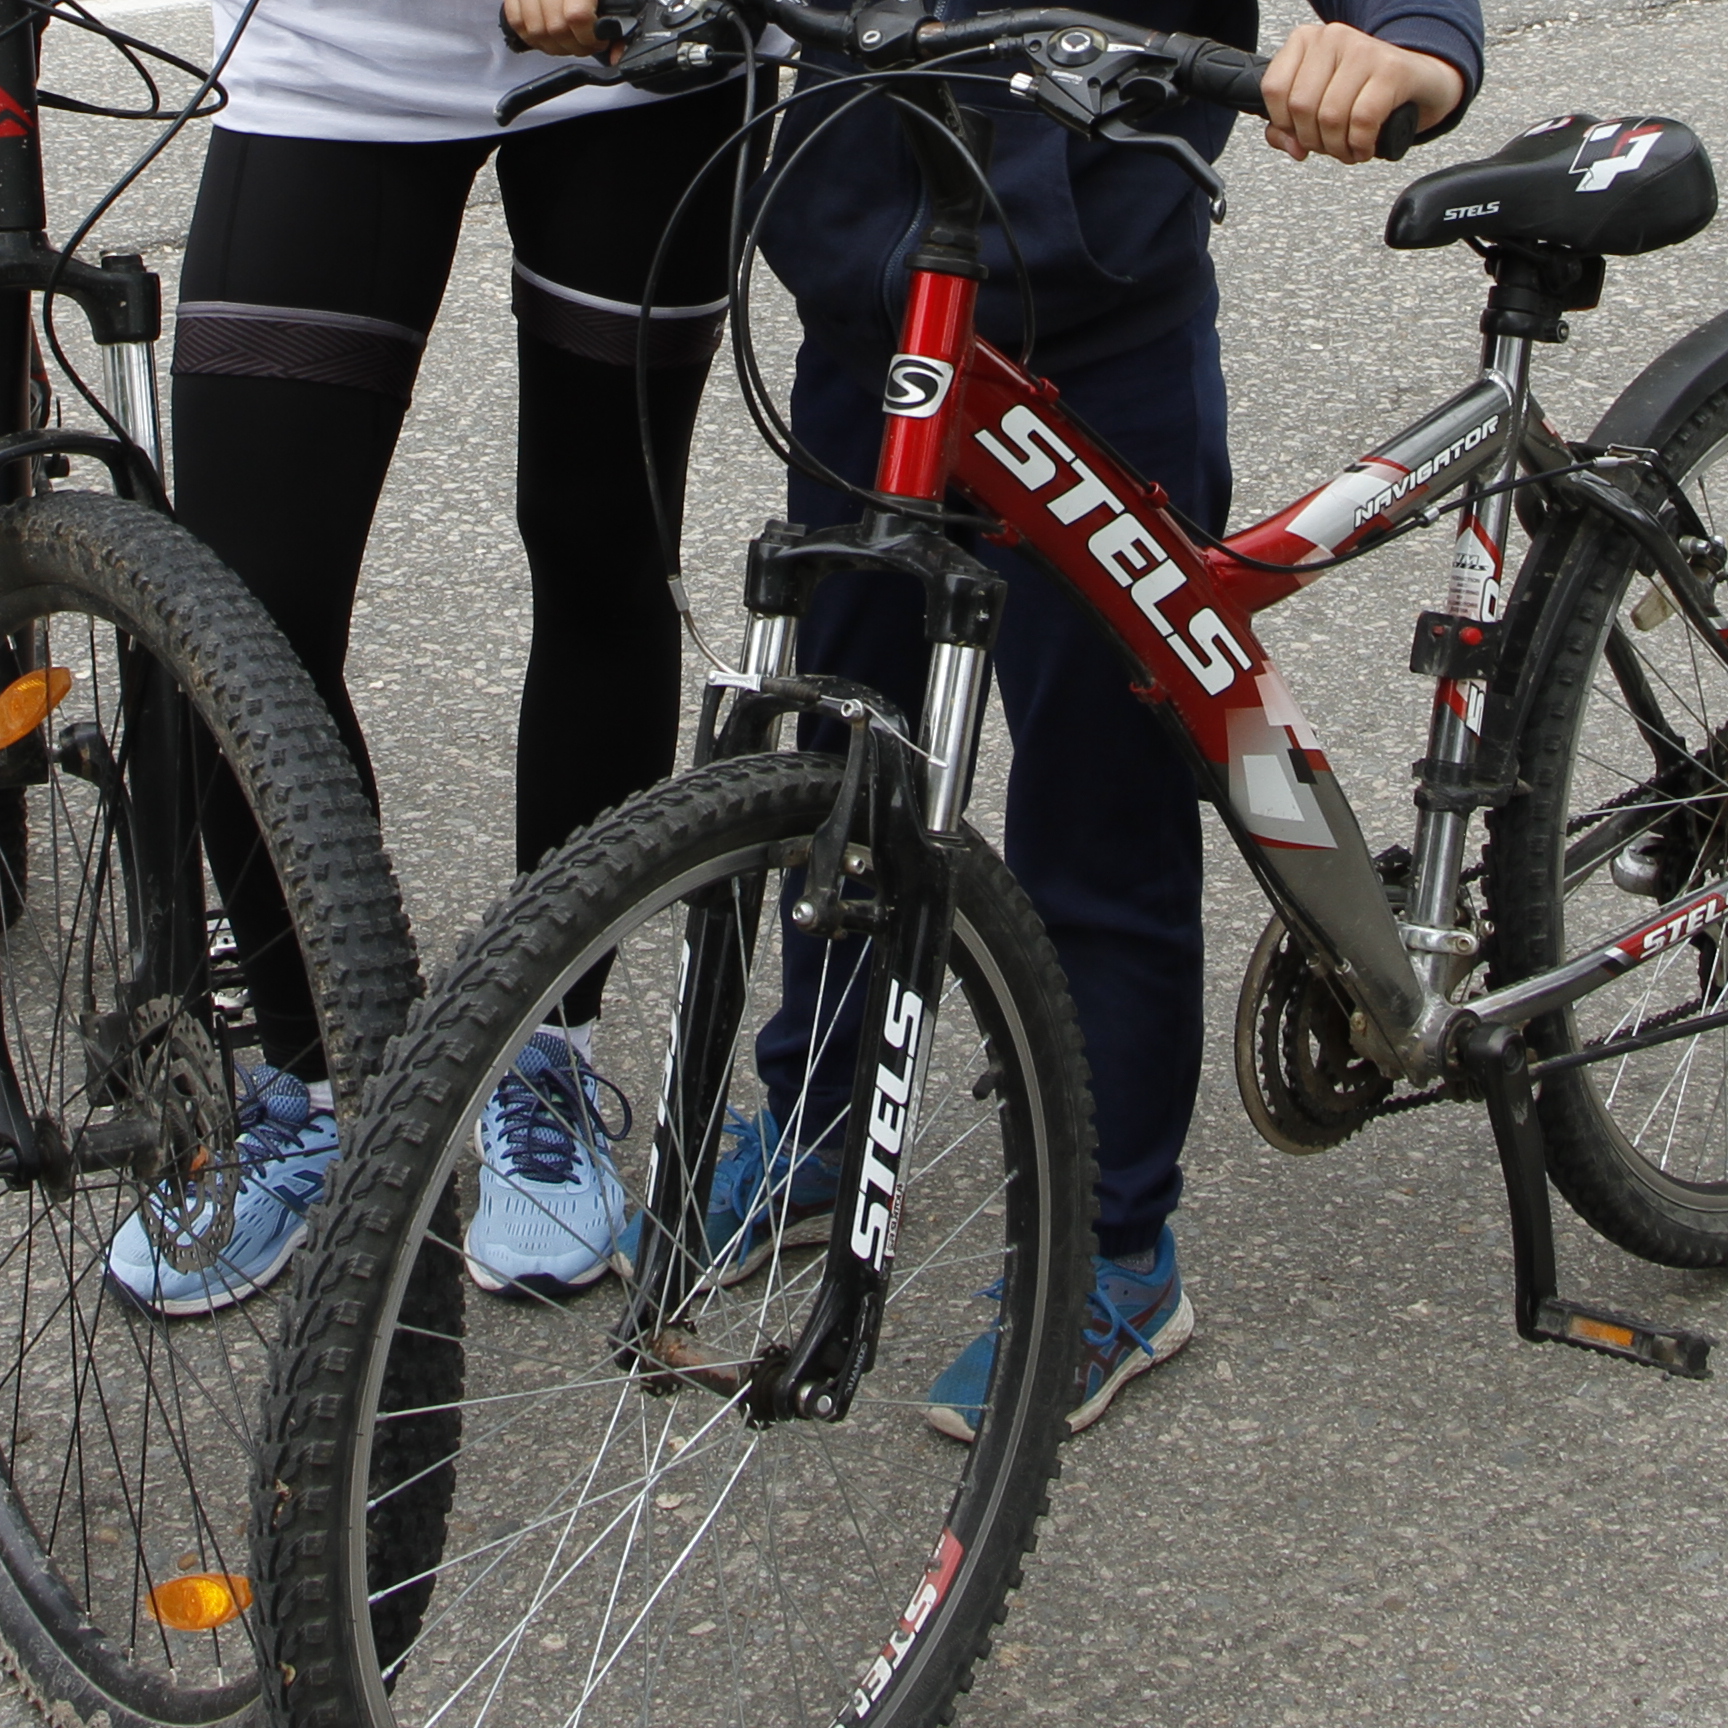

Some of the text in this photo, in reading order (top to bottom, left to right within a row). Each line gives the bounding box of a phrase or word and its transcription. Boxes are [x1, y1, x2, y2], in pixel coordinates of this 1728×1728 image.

[1443, 201, 1500, 221] STELS
[974, 404, 1252, 697] STELS
[1353, 414, 1500, 529] NAVIGATOR
[850, 978, 924, 1271] STELS
